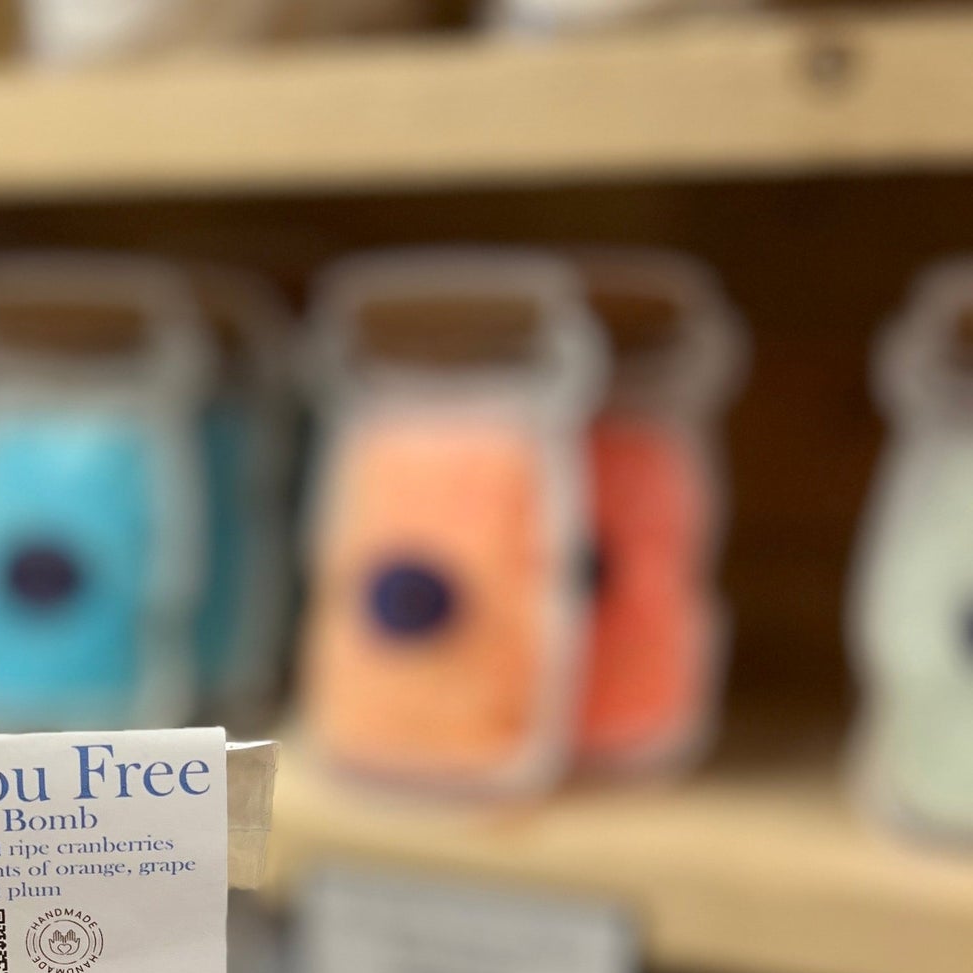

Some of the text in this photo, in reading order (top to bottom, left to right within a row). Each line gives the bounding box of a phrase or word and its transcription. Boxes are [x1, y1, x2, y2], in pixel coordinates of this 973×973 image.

[72, 745, 210, 799] Free
[3, 806, 97, 831] Bomb
[9, 840, 49, 861] ripe
[57, 837, 173, 854] cranberries
[28, 860, 51, 876] of
[56, 863, 132, 878] orange,
[139, 860, 196, 877] grape
[8, 882, 62, 901] plum
[30, 908, 98, 930] HANDMADE
